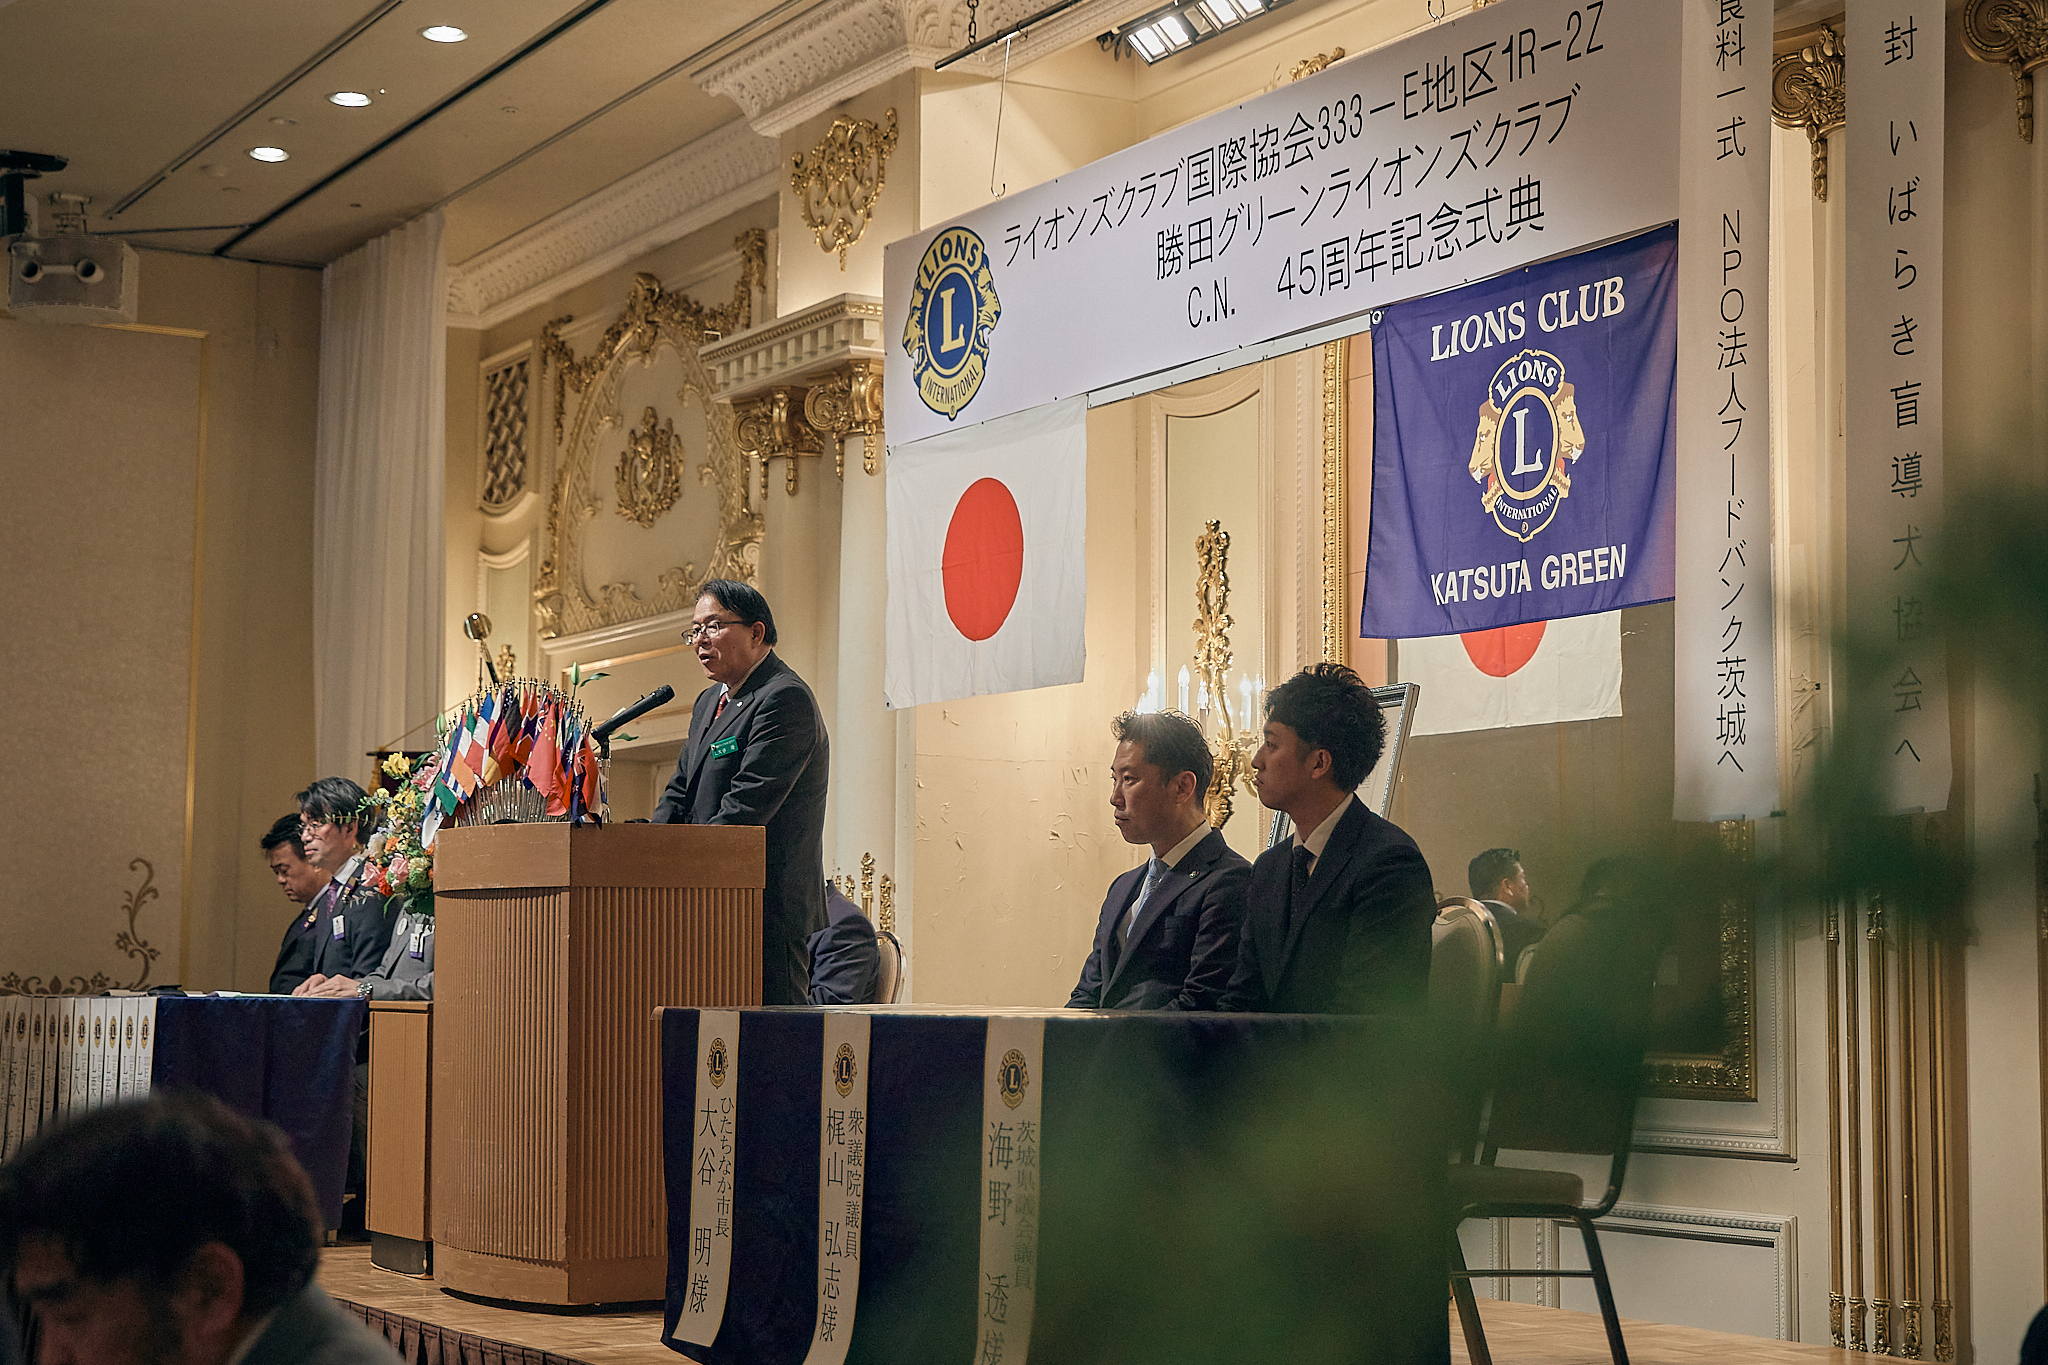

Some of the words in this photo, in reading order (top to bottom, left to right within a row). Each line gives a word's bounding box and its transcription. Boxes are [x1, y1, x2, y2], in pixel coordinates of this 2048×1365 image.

[1156, 82, 1581, 281] 勝田グリーンライオンズクラブ
[923, 234, 980, 283] LIONS
[1187, 276, 1236, 328] C.N.
[1277, 174, 1545, 300] 45周年記念式典
[940, 287, 966, 354] L
[1430, 299, 1527, 362] LIONS
[1537, 275, 1626, 333] CLUB
[924, 363, 980, 405] INTERNATIONAL
[1495, 359, 1558, 402] LIONS
[1511, 407, 1544, 477] L
[1494, 487, 1559, 521] INTERNATIONAL
[1715, 208, 1748, 773] NPO法人フードバンク茨城へ
[1430, 558, 1532, 607] KATSUTA
[1540, 543, 1627, 591] GREEN
[714, 1096, 735, 1238] ひたちなか市長
[844, 1106, 865, 1261] 衆議院議員
